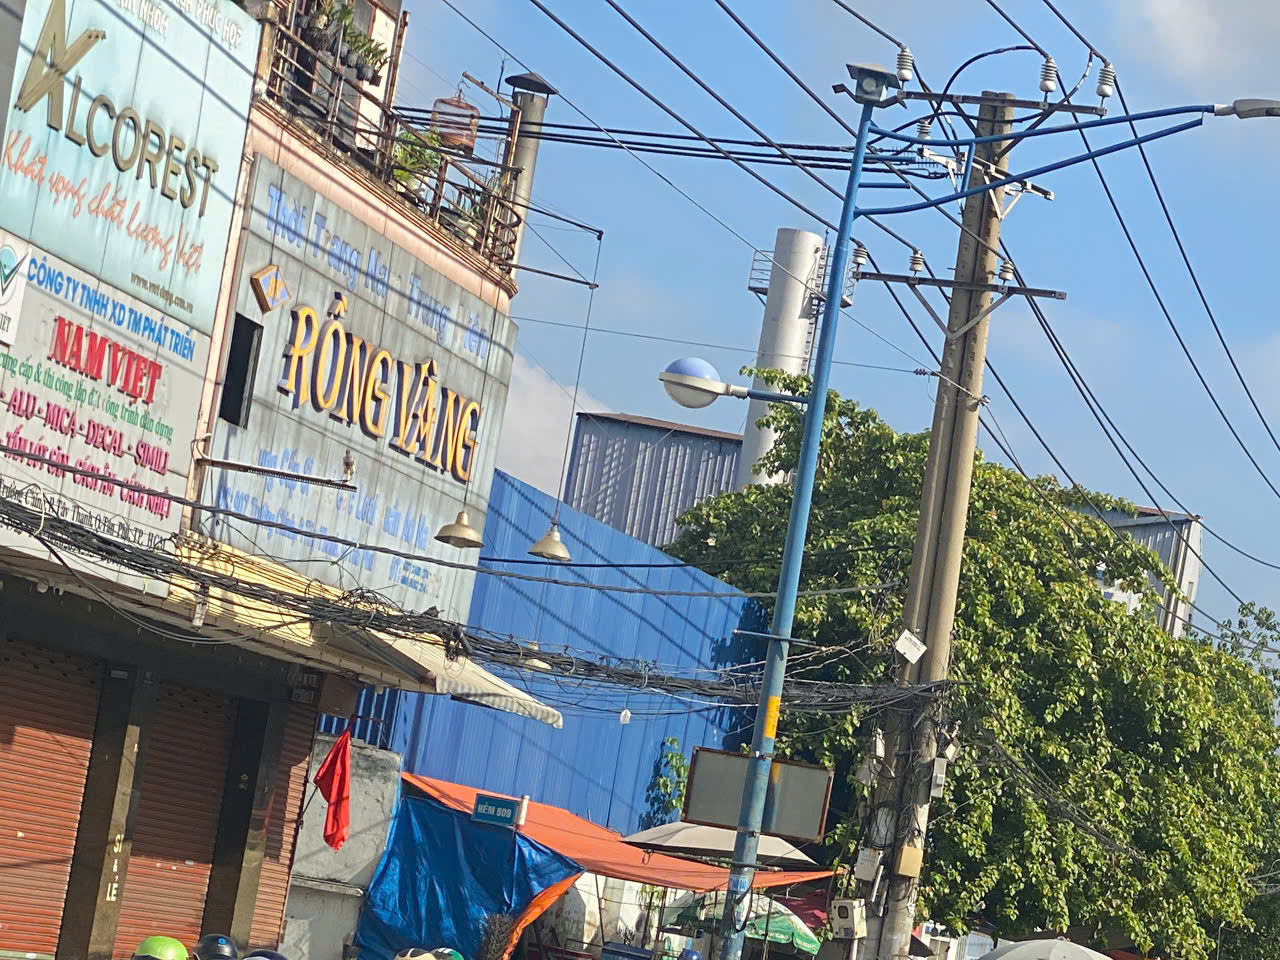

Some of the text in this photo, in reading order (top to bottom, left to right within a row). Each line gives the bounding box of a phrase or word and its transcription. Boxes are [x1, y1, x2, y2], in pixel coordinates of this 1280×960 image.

[313, 212, 361, 291] Tang
[27, 255, 64, 295] CÔNG
[65, 276, 80, 301] TY
[80, 283, 110, 319] TNHH
[109, 297, 126, 327] XD
[127, 307, 142, 337] TM
[142, 315, 169, 346] PHÁT
[34, 362, 42, 384] &
[55, 374, 74, 401] công
[48, 315, 163, 406] NAM VIỆT
[7, 388, 38, 421] ALU
[44, 402, 77, 438] MICA
[85, 418, 125, 458] DECAL
